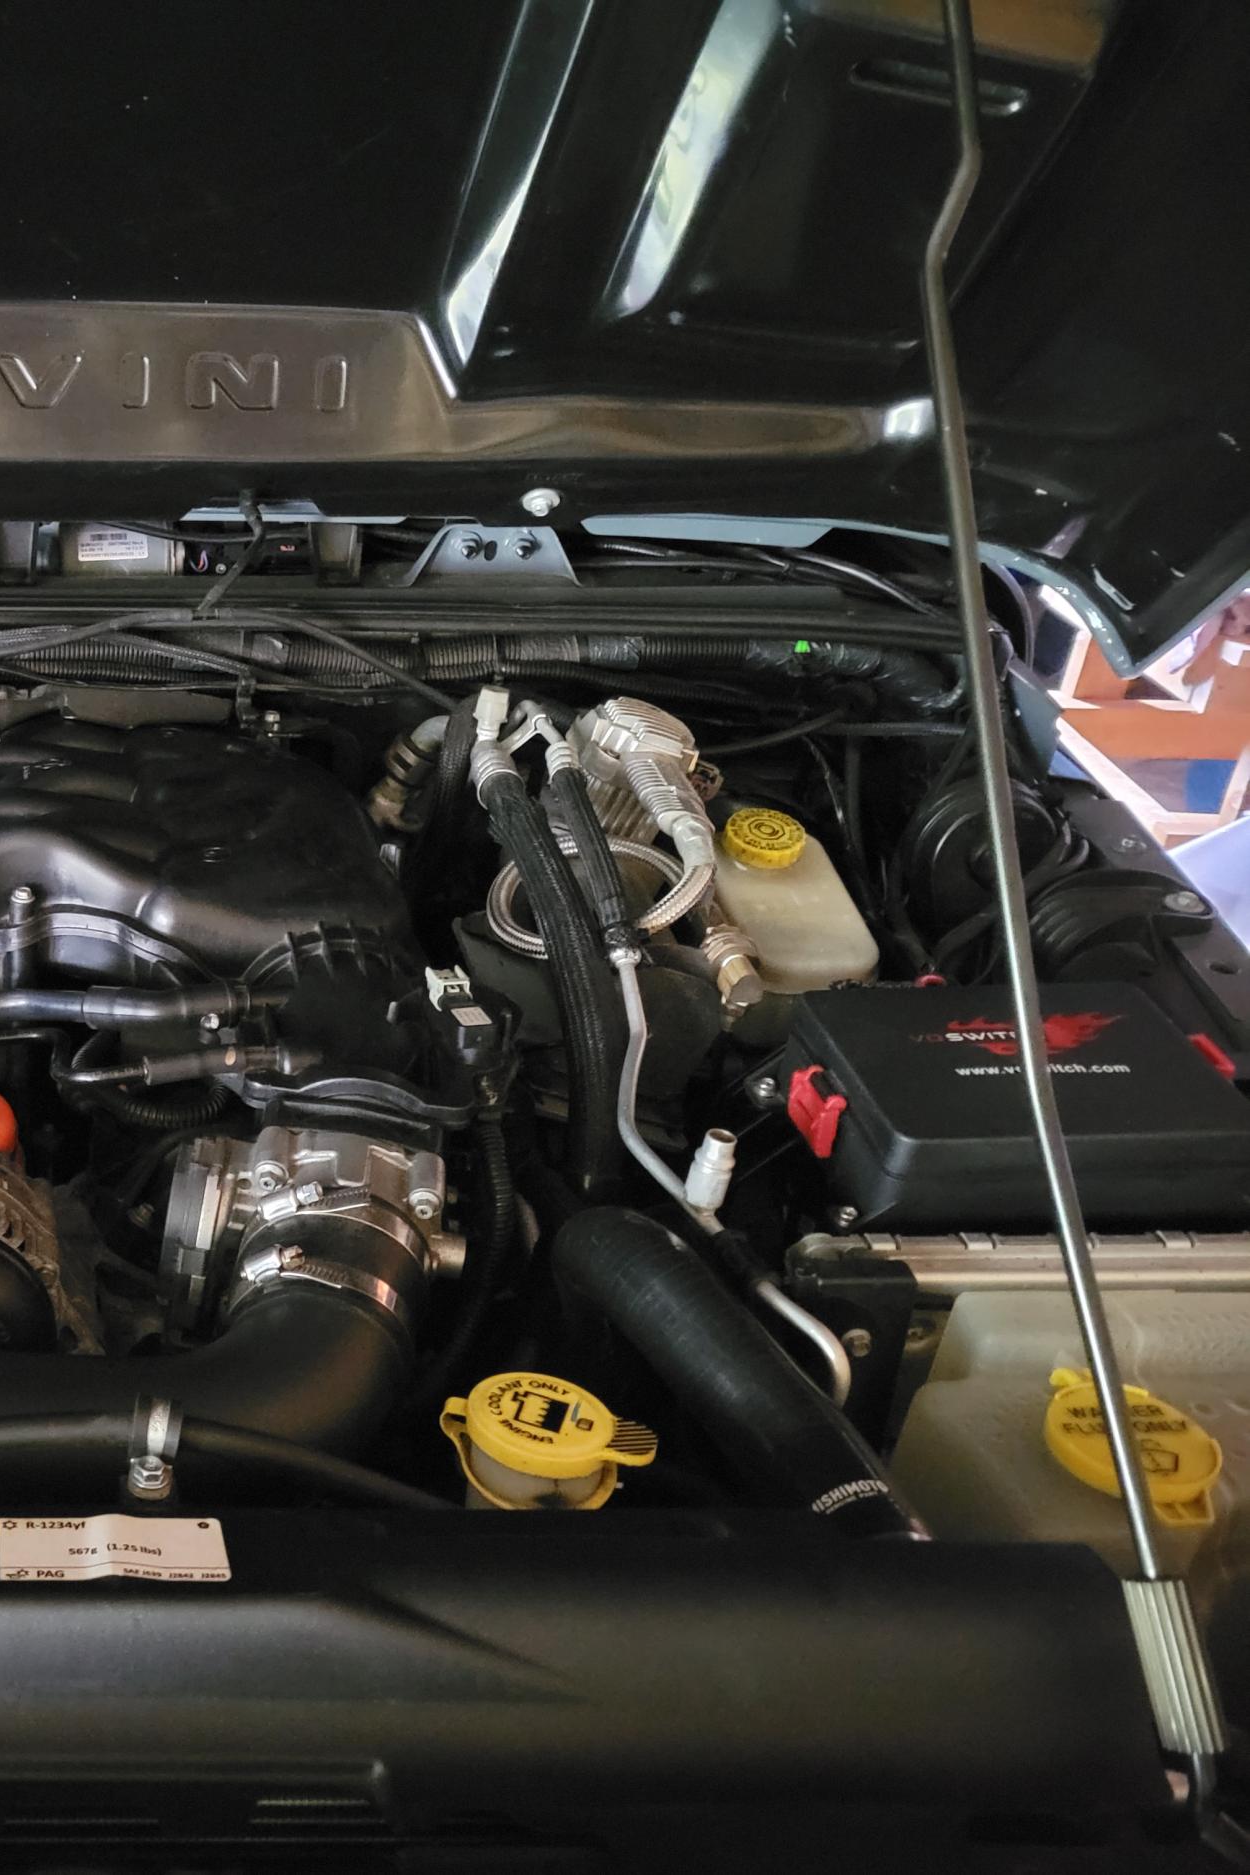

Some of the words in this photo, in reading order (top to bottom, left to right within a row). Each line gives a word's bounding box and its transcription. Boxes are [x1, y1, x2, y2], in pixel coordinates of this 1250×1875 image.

[528, 1380, 571, 1396] ONLY
[26, 1520, 86, 1531] R-1234yf
[106, 1542, 138, 1553] (1.25
[139, 1545, 162, 1557] lbs)
[36, 1569, 65, 1578] PAG
